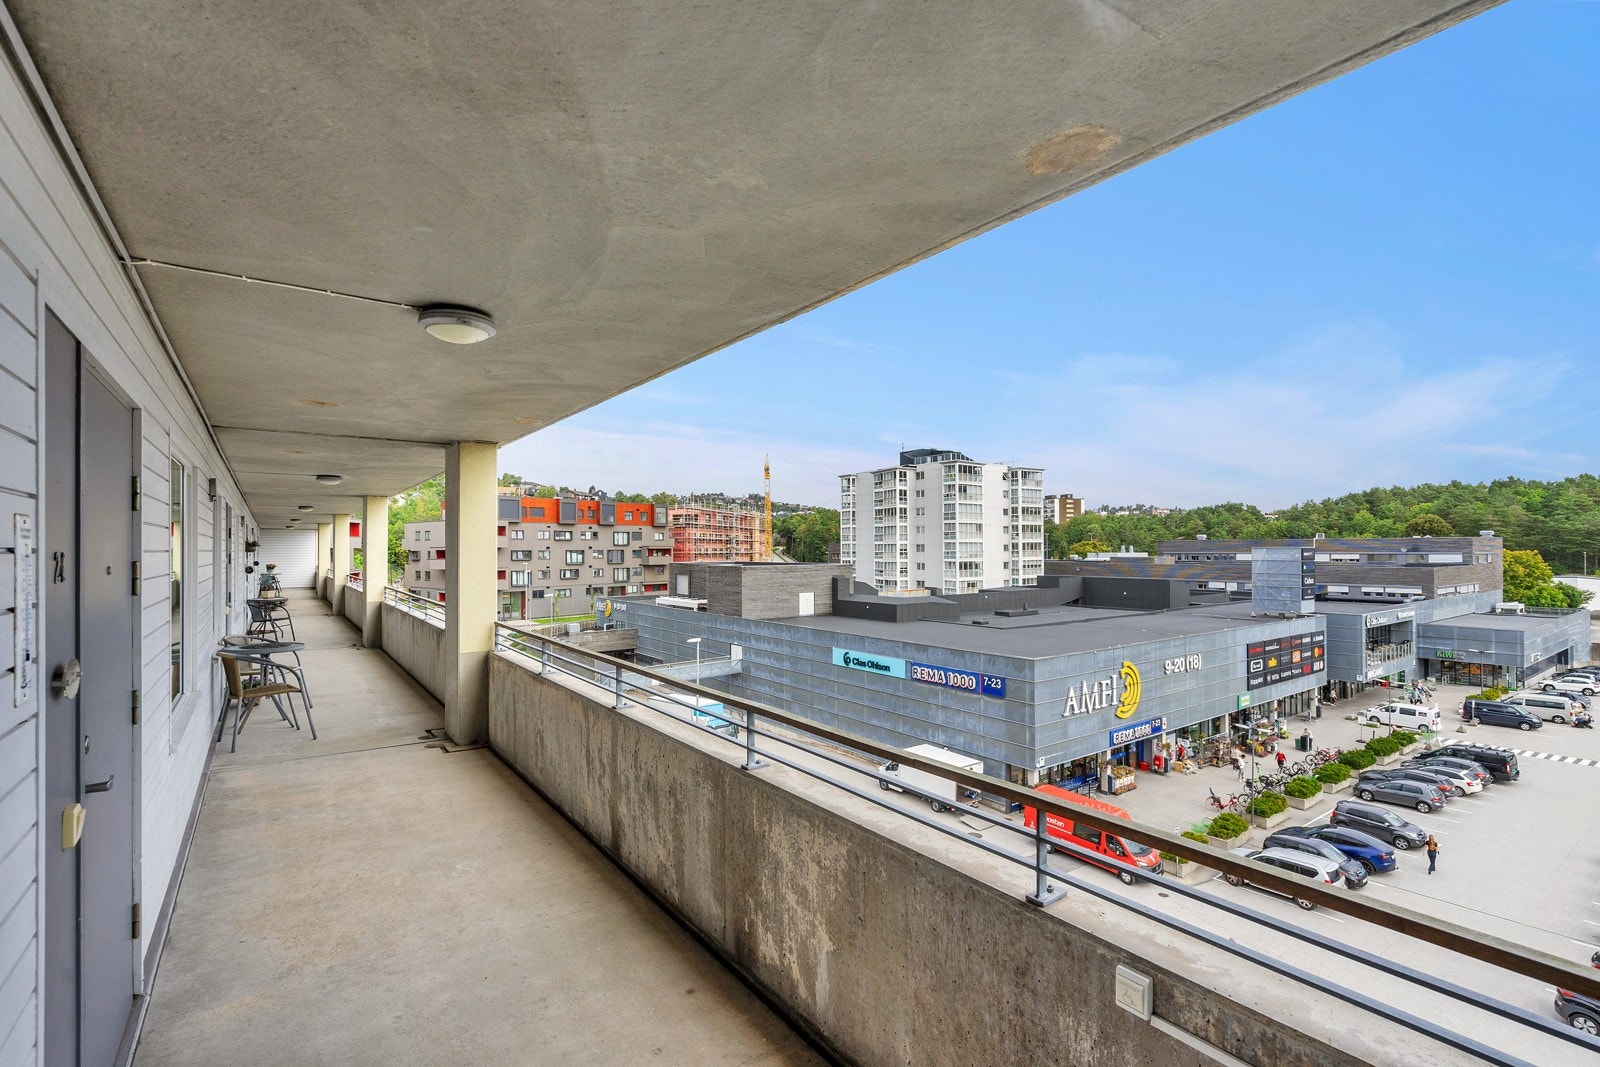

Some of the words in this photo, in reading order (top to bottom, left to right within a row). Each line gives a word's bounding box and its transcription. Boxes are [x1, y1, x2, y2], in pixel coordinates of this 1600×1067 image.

[852, 657, 867, 668] Clas
[867, 660, 891, 672] Ohlson
[1164, 659, 1186, 675] 9-20
[1186, 653, 1202, 673] (18)
[911, 665, 946, 685] REMA
[947, 672, 977, 691] 1000
[983, 676, 1002, 689] 7-23
[1062, 673, 1118, 718] AMFI
[1113, 728, 1136, 745] REMA
[1134, 723, 1152, 738] 1000
[1046, 816, 1065, 829] osten
